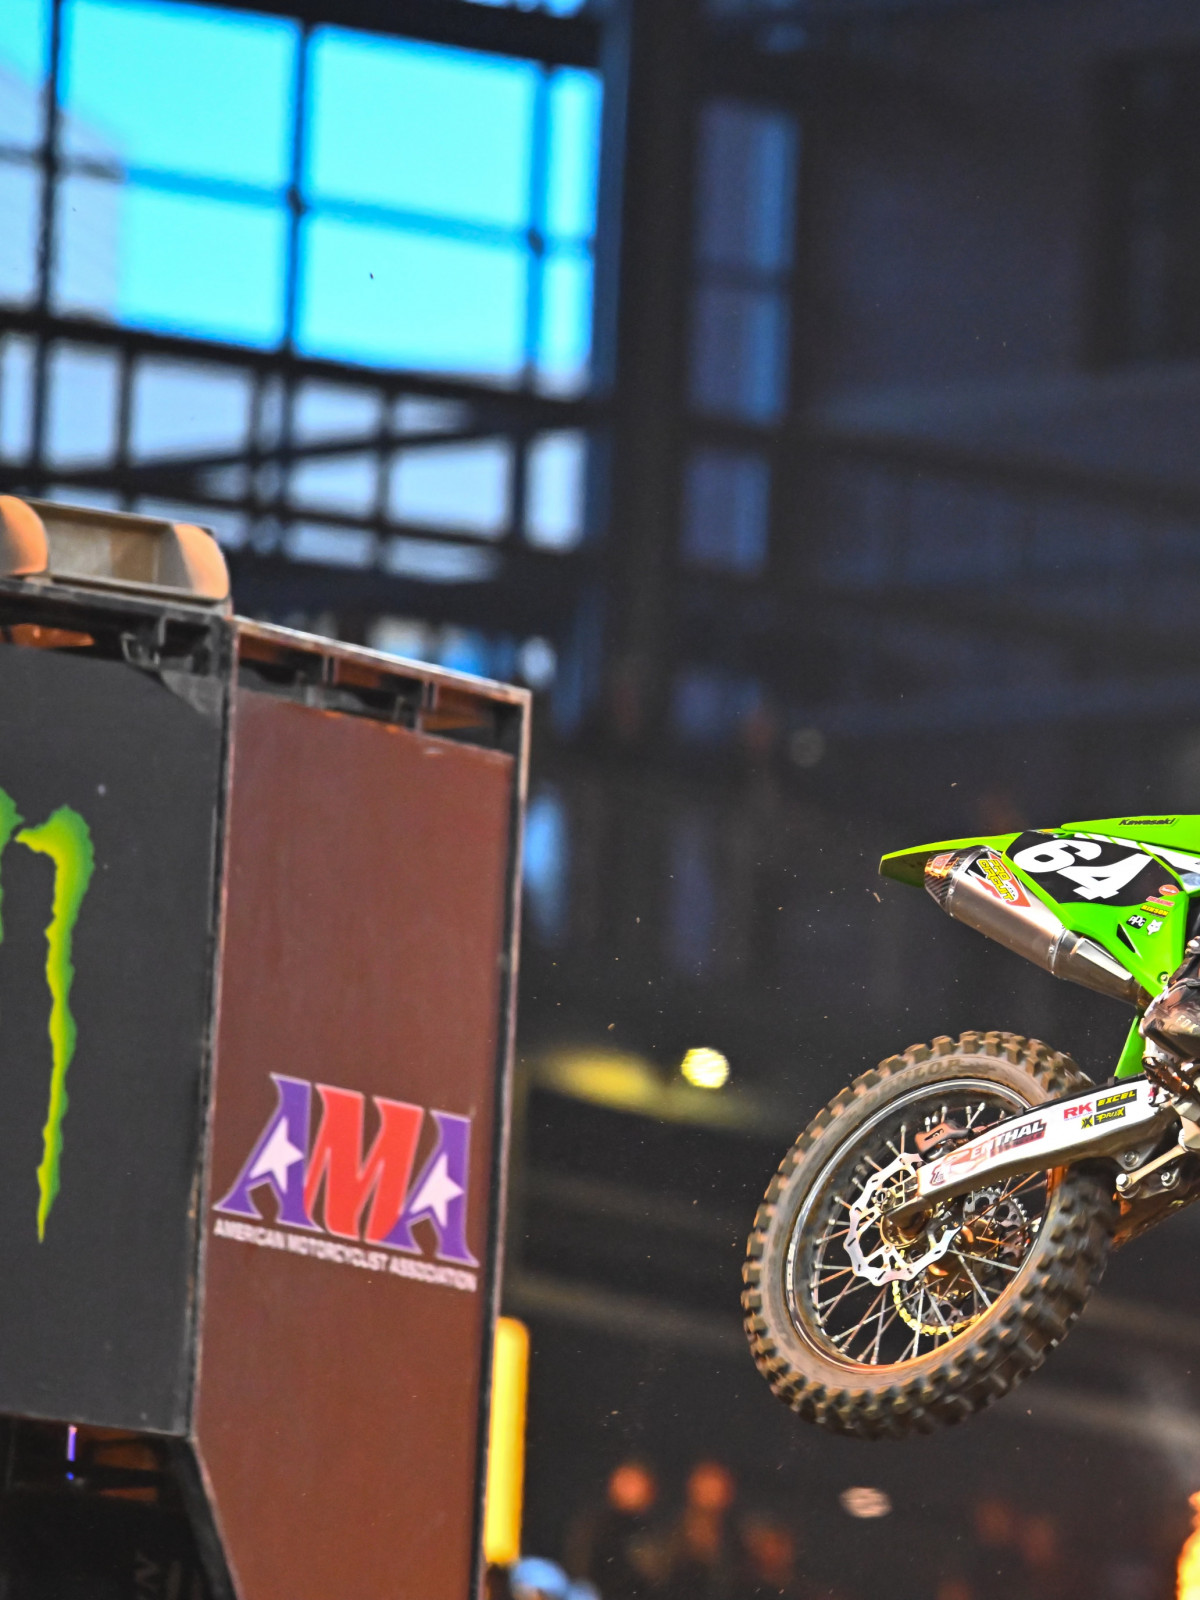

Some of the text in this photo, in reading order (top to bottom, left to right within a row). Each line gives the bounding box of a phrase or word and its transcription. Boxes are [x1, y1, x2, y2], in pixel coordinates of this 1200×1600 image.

[1118, 817, 1177, 826] Kawasaki
[989, 859, 1011, 881] PRO
[1013, 838, 1154, 902] 64
[978, 859, 1015, 901] CIRCUIT
[1140, 905, 1170, 917] HINSON
[1127, 914, 1146, 928] PPG
[1096, 1090, 1136, 1107] EXCEL
[1064, 1102, 1093, 1119] RK
[212, 1072, 480, 1268] AMA
[213, 1218, 478, 1292] AMERICAN MOTORCYCLIST ASSOCIATION
